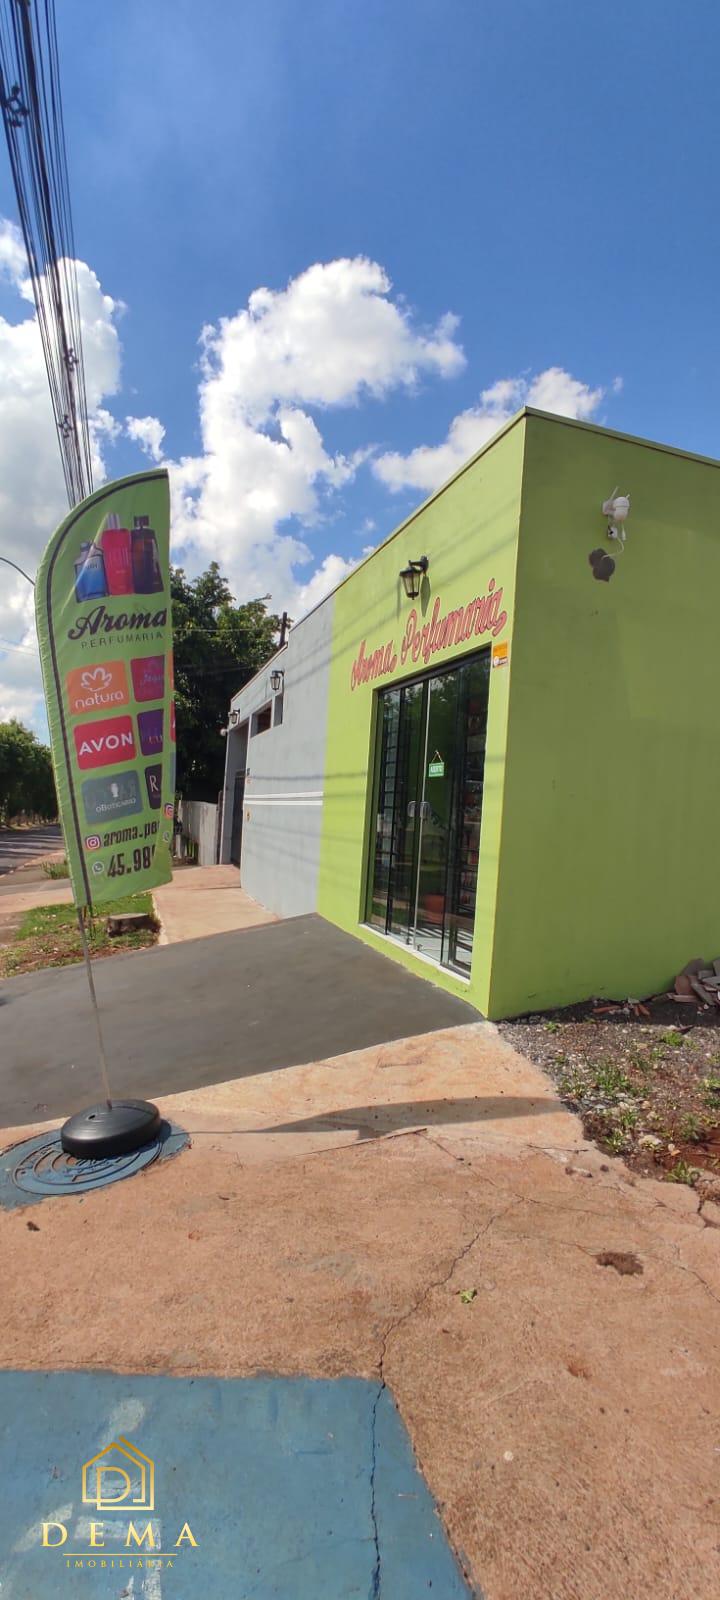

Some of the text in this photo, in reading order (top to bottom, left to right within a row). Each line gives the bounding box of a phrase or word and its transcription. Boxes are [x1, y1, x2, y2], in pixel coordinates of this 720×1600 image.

[67, 605, 168, 641] Aroma
[81, 632, 164, 650] PERFUMARIA
[75, 690, 125, 709] natura
[79, 732, 134, 756] AVON
[107, 844, 156, 878] 45.98
